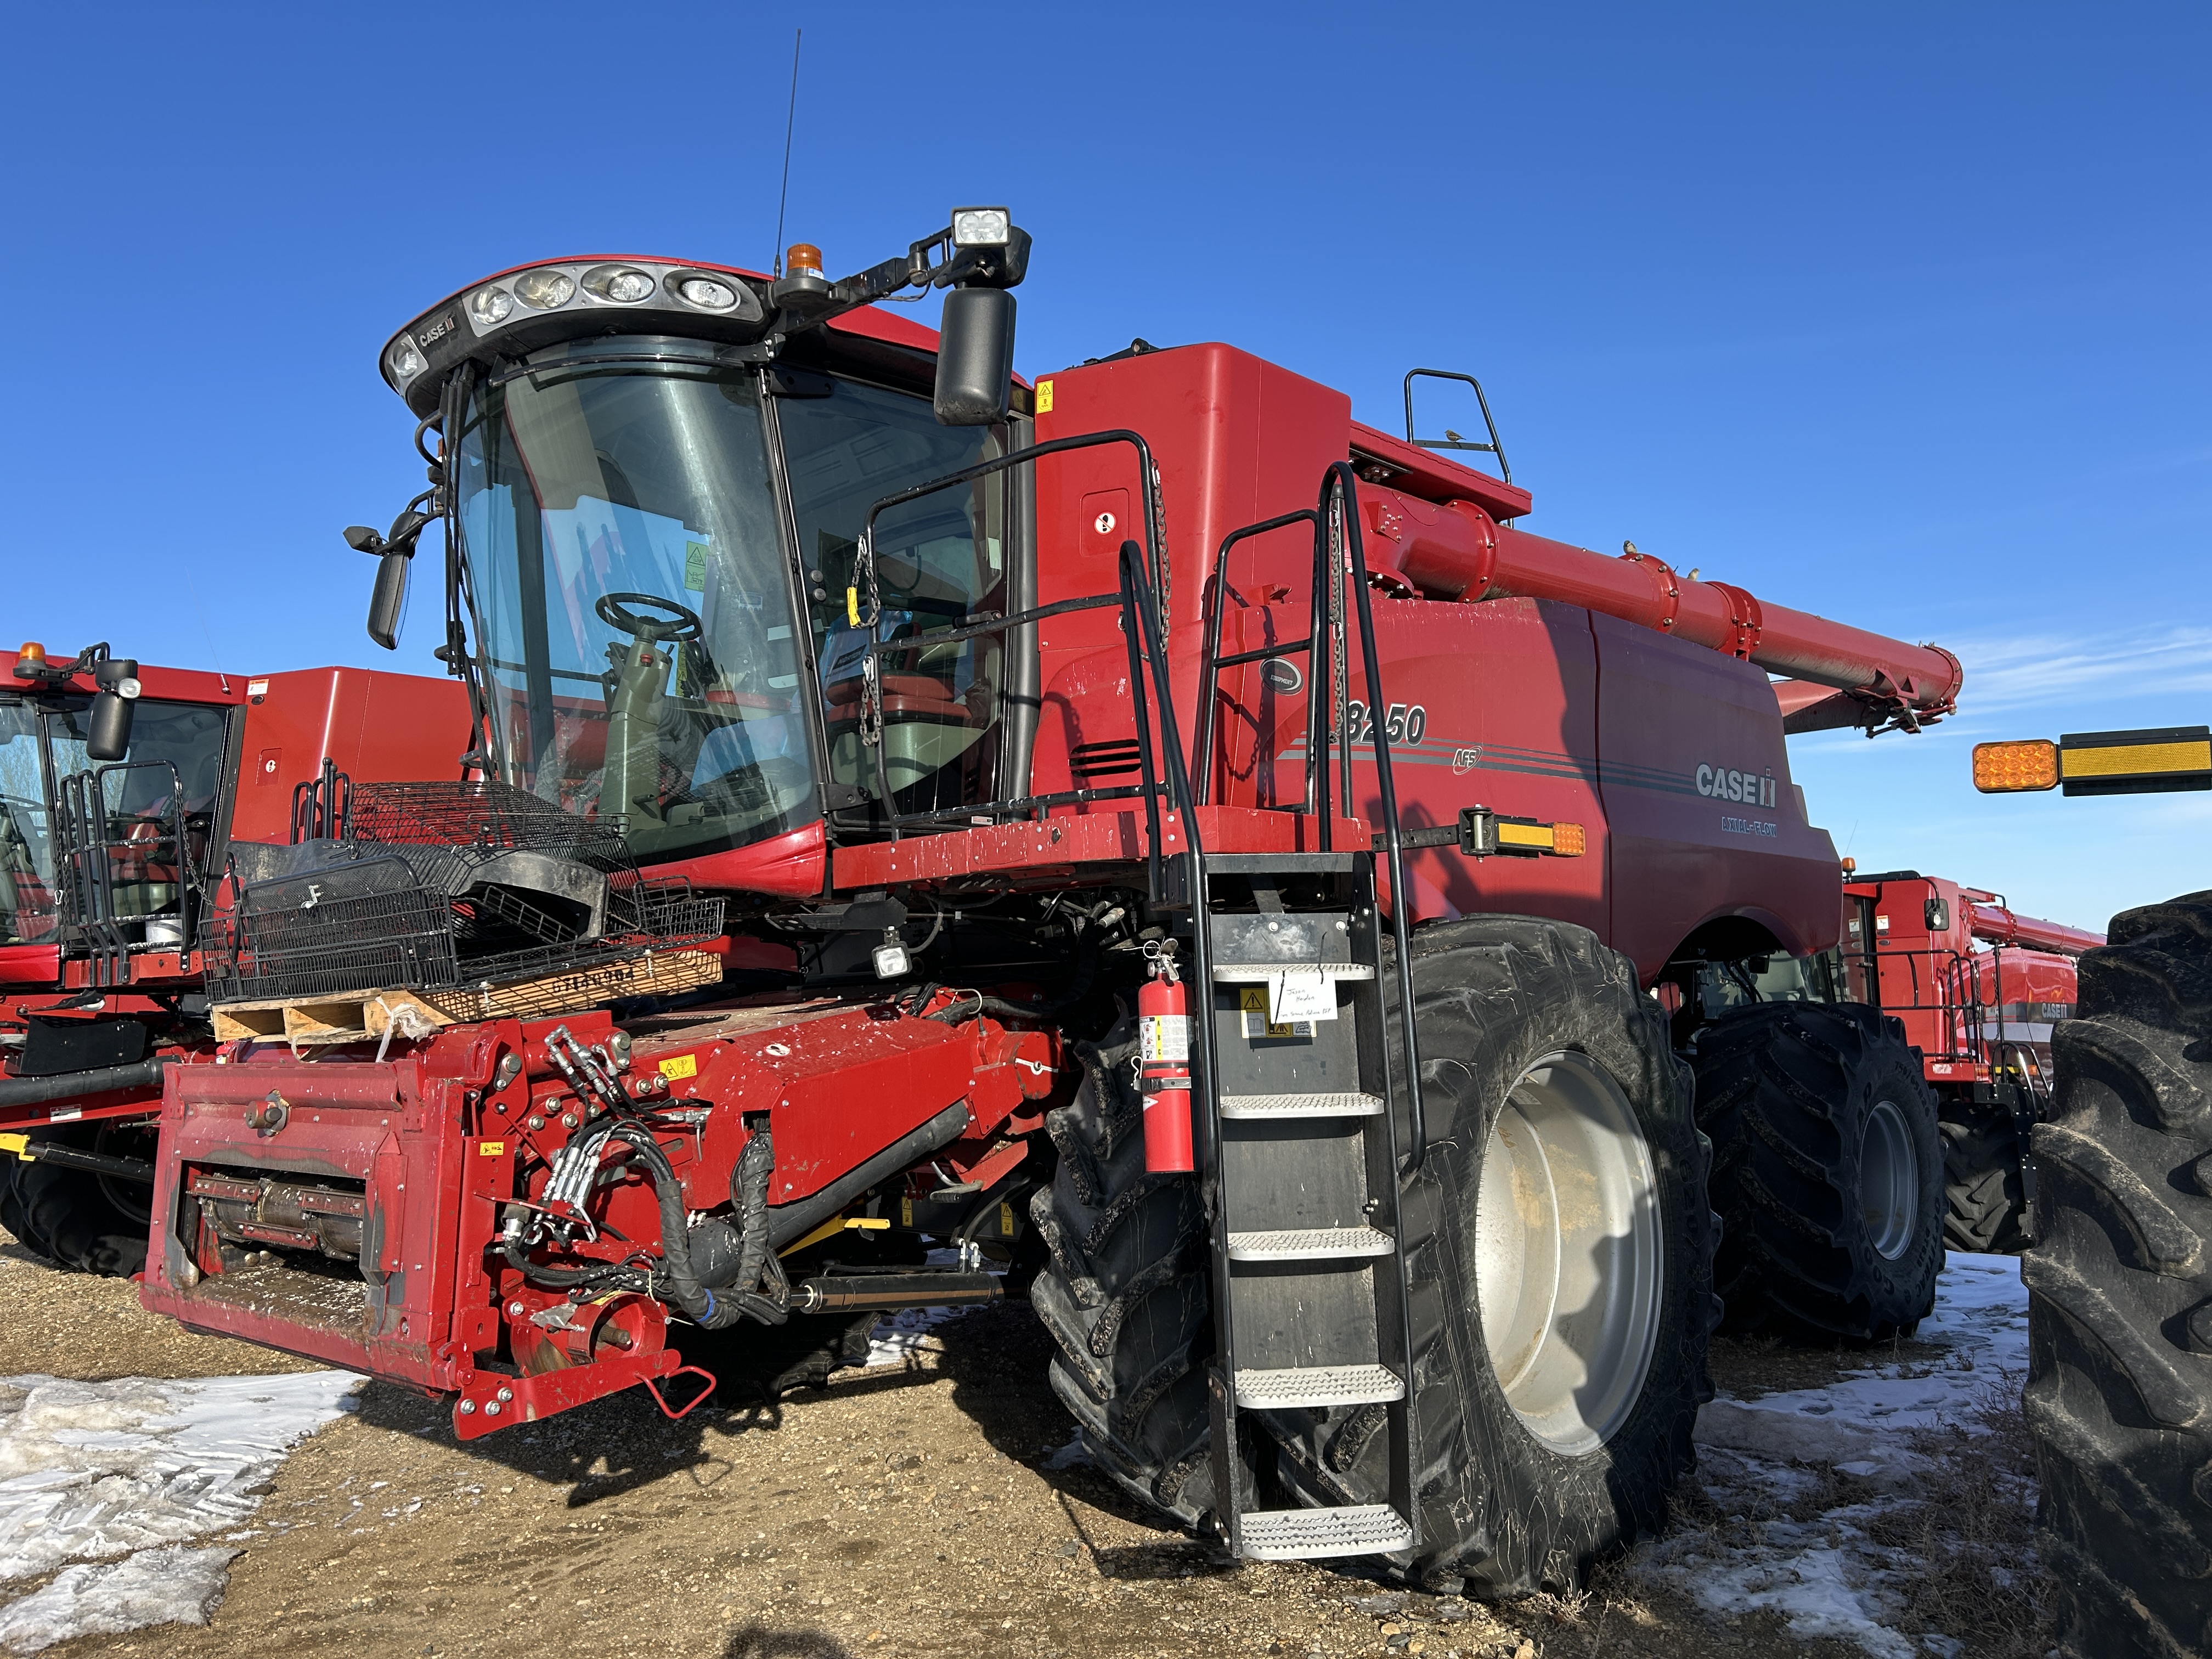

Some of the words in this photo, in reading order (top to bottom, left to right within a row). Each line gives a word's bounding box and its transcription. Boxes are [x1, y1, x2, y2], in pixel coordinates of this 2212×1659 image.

[419, 324, 445, 347] CASE
[1453, 748, 1477, 768] AFS
[1696, 764, 1756, 804] CASE
[1722, 816, 1778, 838] AXIAL-FLOW
[2041, 1002, 2061, 1019] CASE
